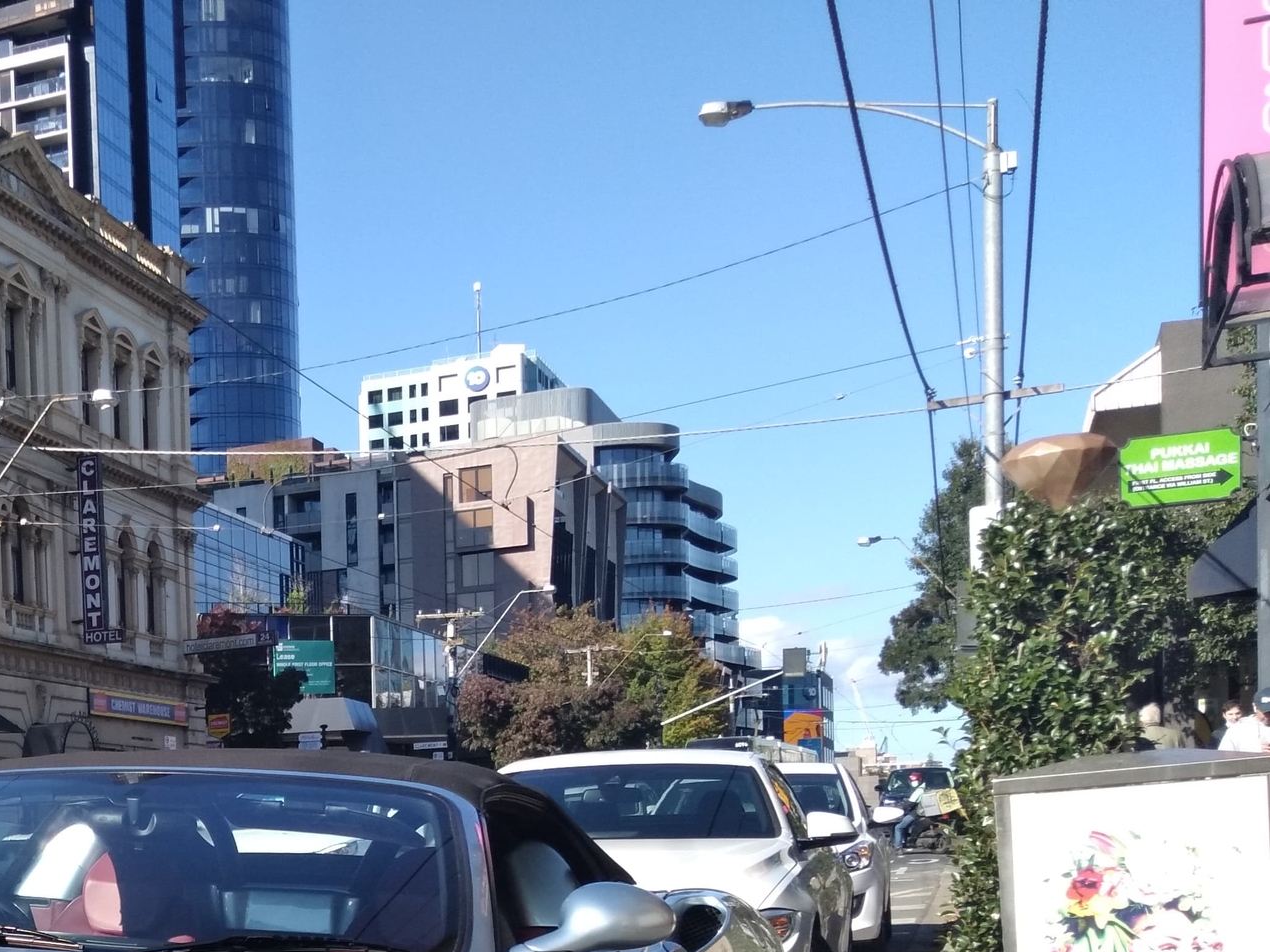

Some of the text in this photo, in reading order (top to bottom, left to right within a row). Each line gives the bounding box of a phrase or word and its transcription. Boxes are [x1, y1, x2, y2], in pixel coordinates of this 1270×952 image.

[466, 370, 487, 386] 10
[1150, 442, 1210, 460] PUKKAI
[1125, 452, 1238, 475] THAI MASSAGE
[1183, 473, 1202, 481] FROM
[81, 459, 102, 628] CLAREMONT
[85, 630, 122, 644] HOTEL
[260, 633, 270, 641] 24
[111, 698, 136, 713] CHEMIST
[137, 702, 171, 718] WAREHOUSE
